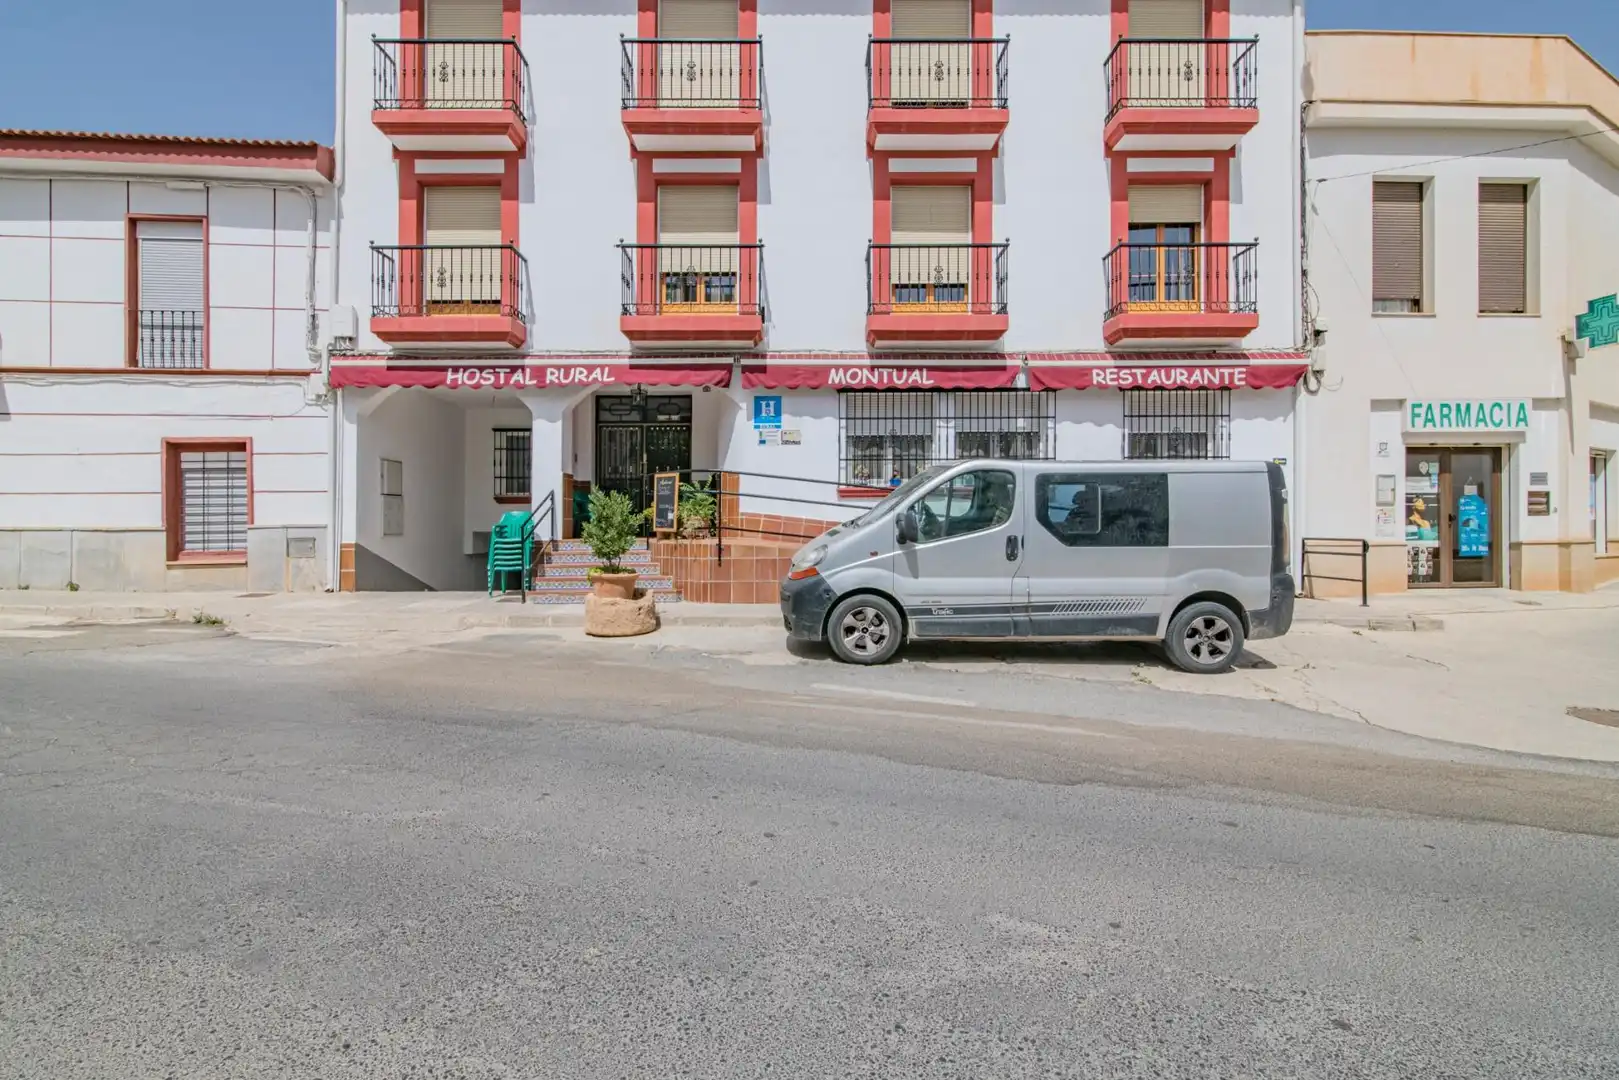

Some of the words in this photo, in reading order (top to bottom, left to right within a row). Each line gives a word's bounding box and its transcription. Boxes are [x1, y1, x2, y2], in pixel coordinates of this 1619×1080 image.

[446, 368, 536, 385] HOSTAL
[545, 366, 614, 384] RURAL
[828, 368, 934, 385] MONTUAL
[1092, 367, 1247, 385] RESTAURANTE
[1410, 402, 1529, 428] FARMACIA
